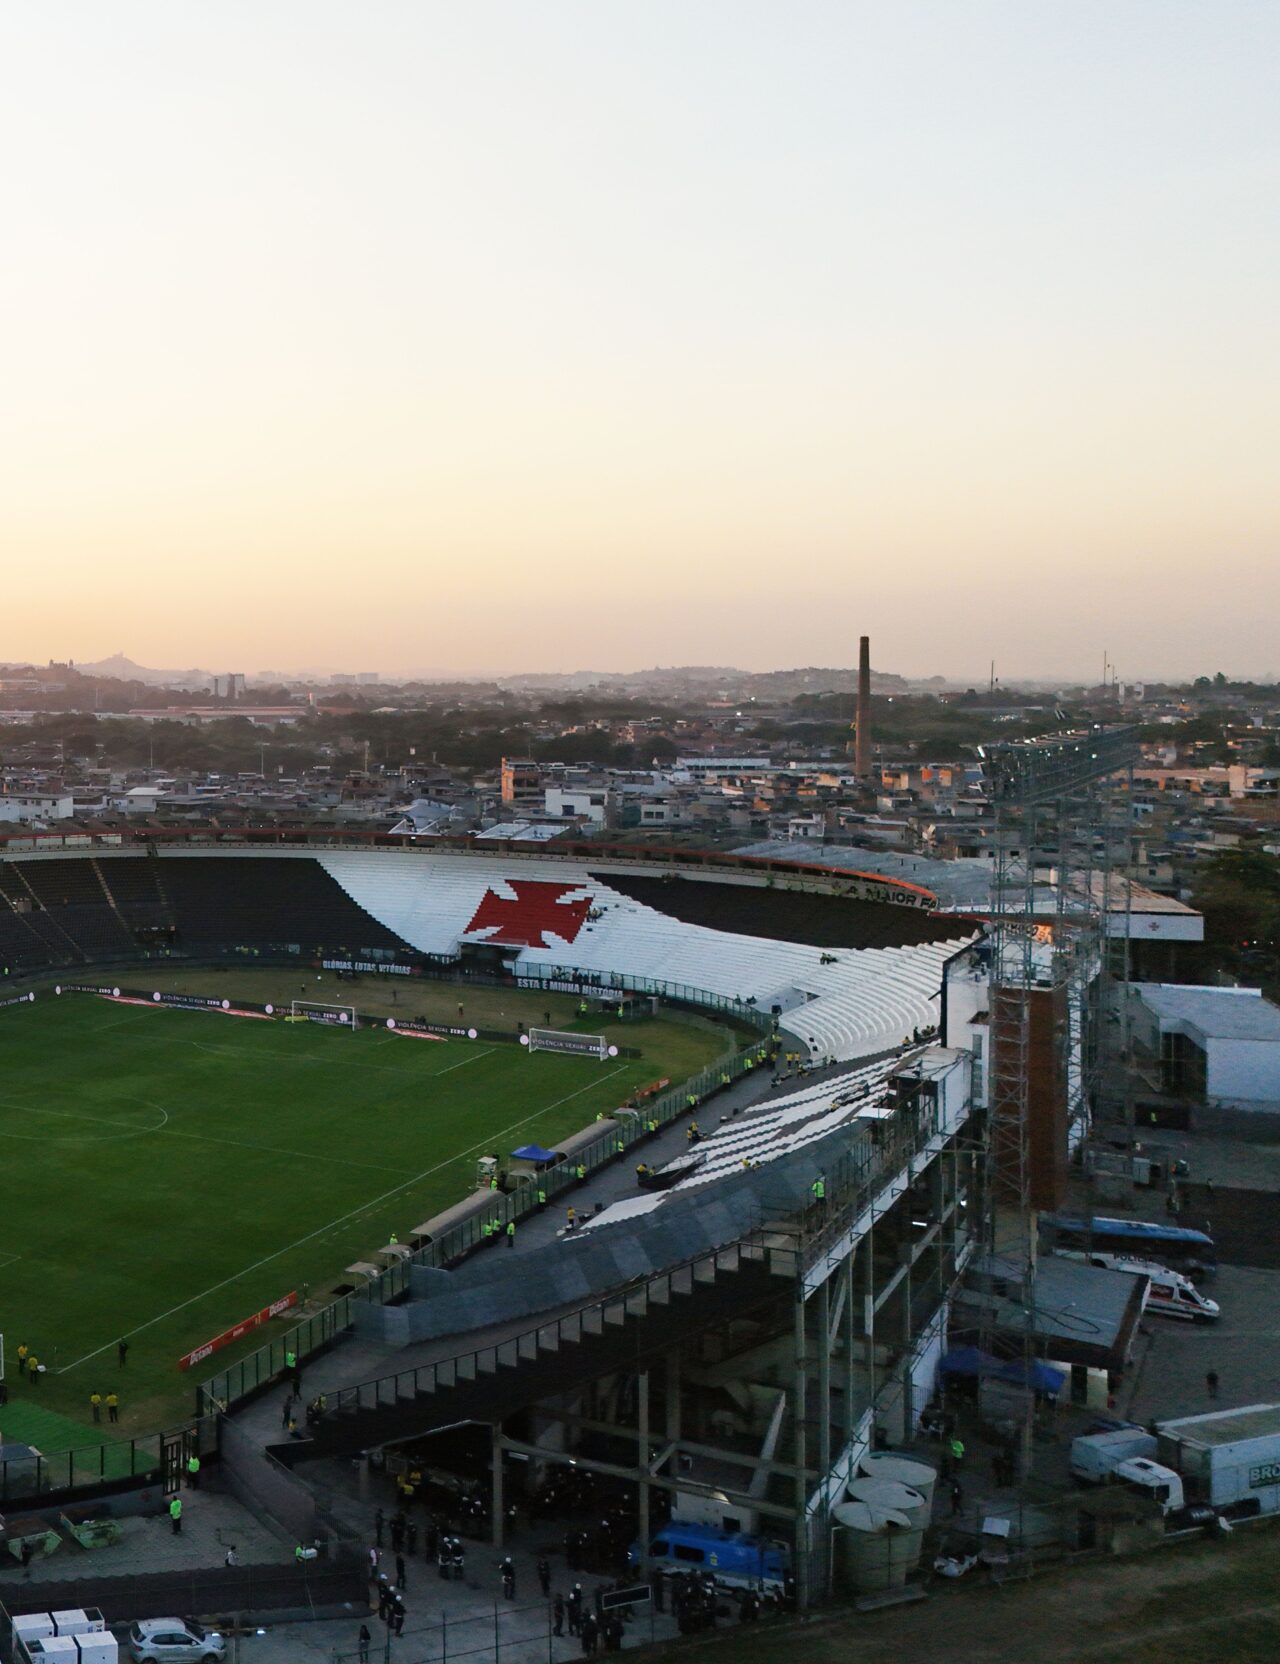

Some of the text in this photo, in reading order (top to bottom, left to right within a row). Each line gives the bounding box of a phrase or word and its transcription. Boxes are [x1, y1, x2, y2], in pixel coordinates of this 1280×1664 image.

[517, 978, 540, 988] ESTA
[549, 981, 580, 993] MINHA
[582, 985, 624, 998] HISTÓRIA
